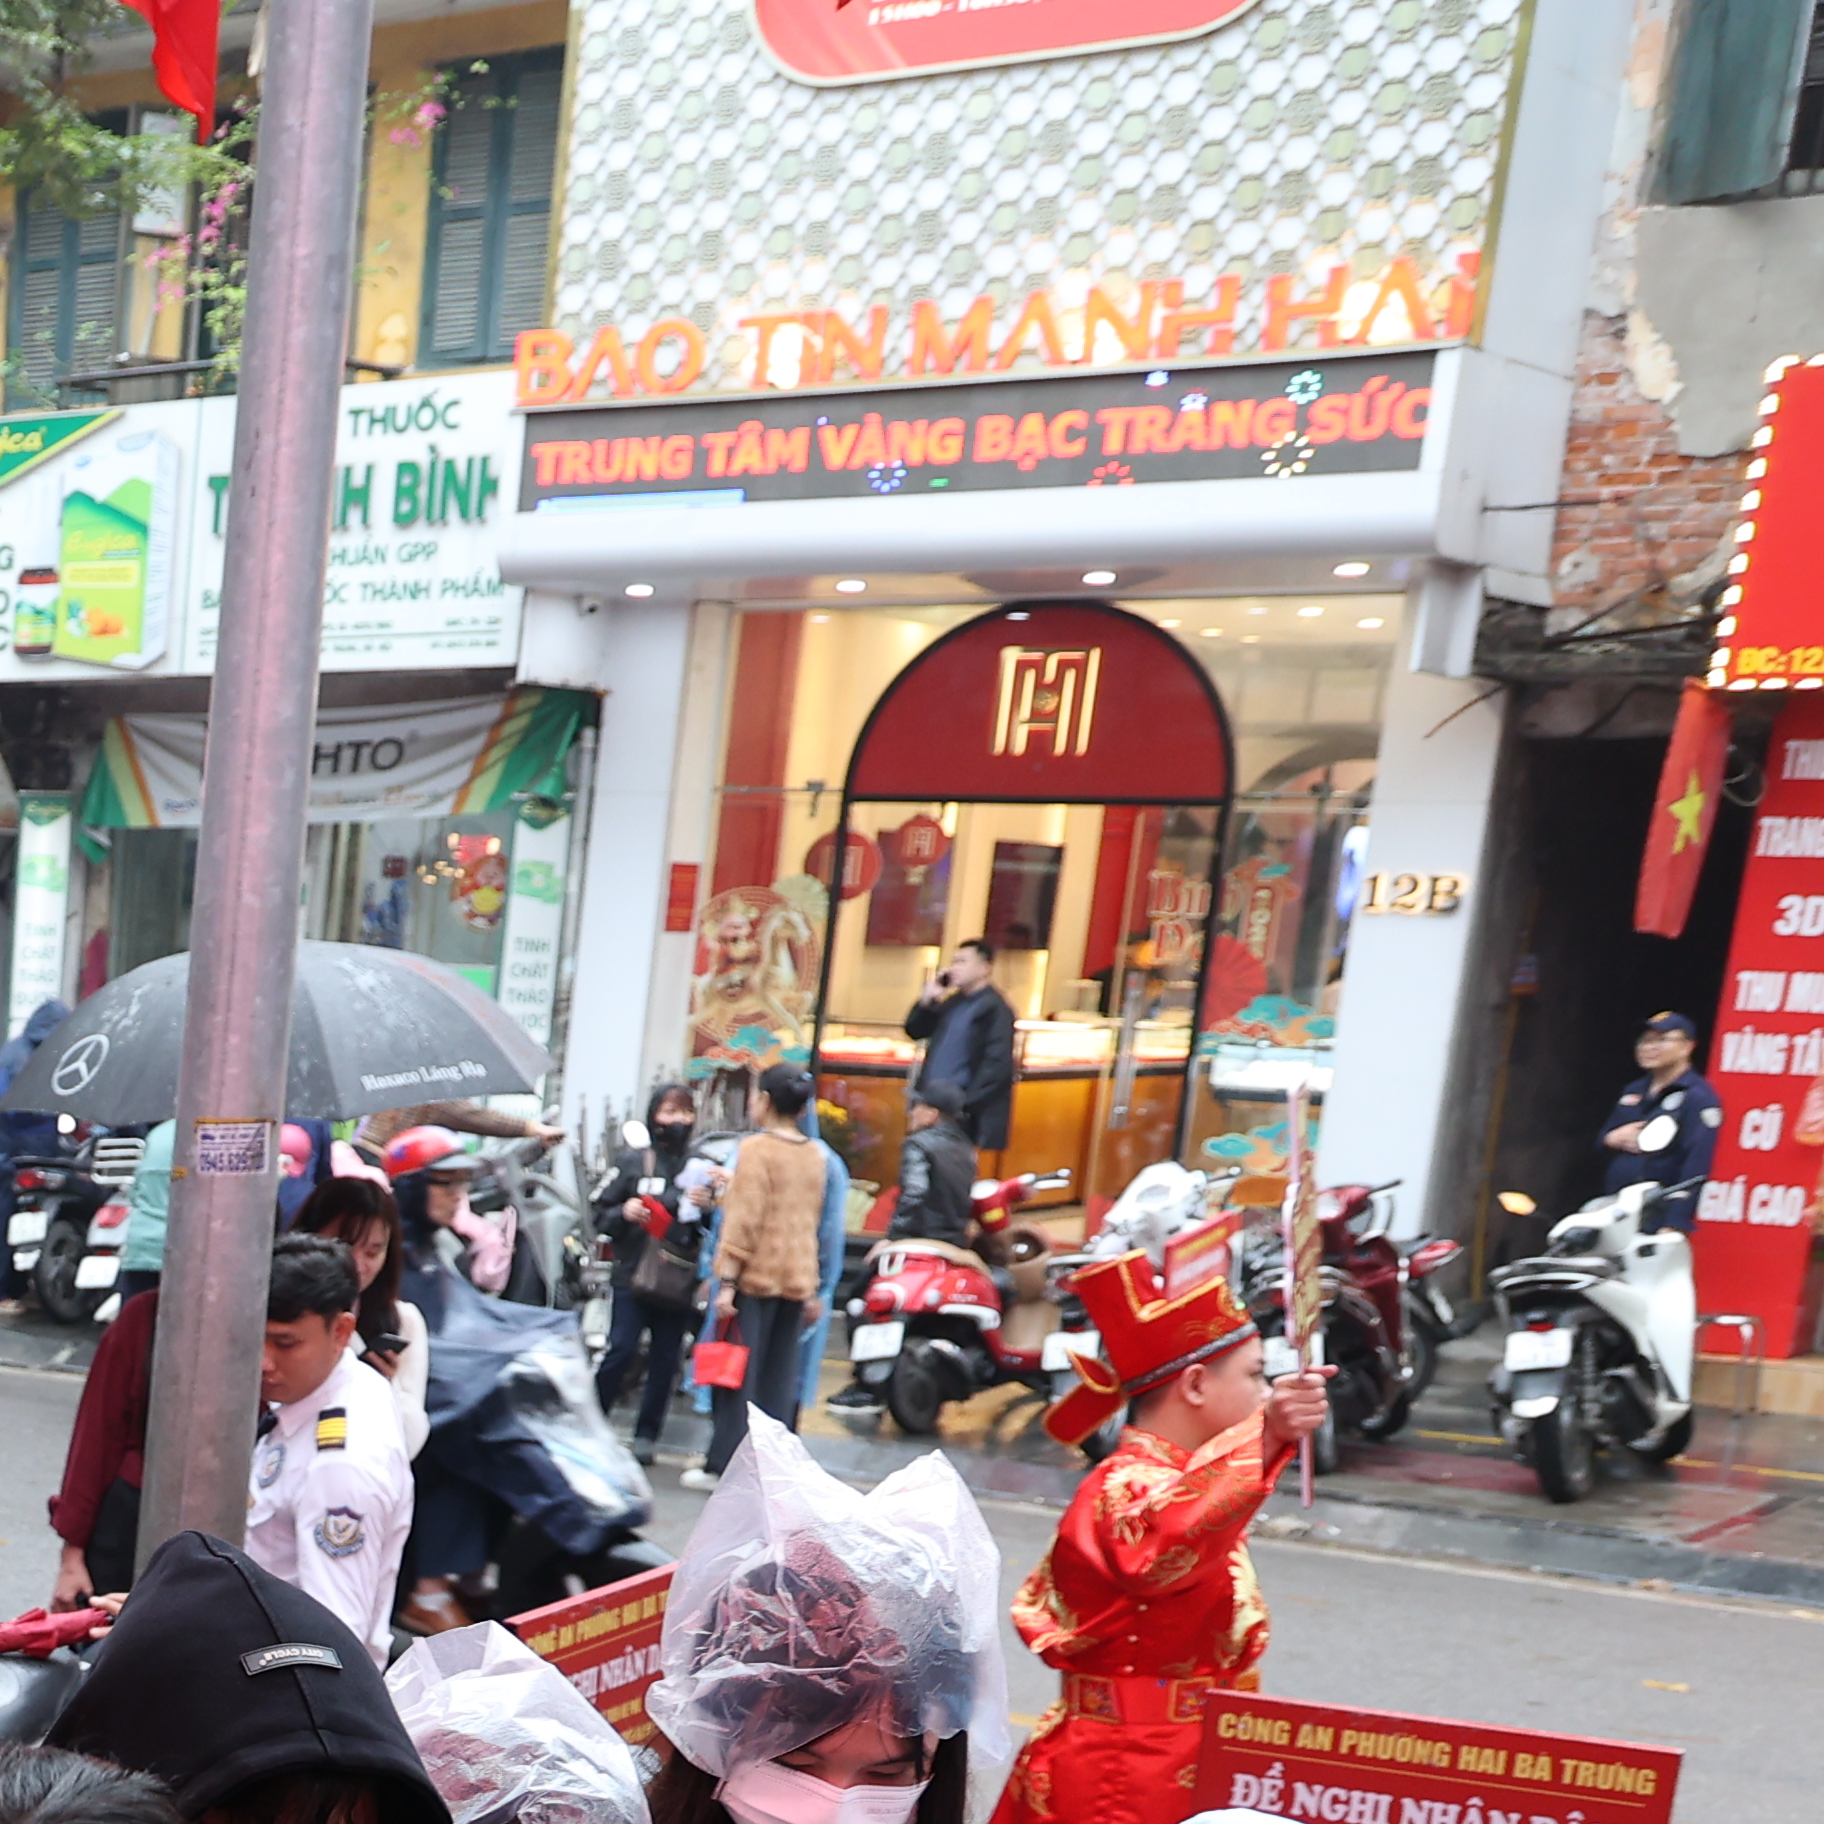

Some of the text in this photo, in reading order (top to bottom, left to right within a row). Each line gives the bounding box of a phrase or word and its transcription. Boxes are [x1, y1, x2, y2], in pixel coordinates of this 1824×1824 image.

[348, 387, 462, 437] THUỐC
[531, 433, 695, 488] TRUNG
[701, 420, 811, 479] TÂM
[815, 412, 968, 471] VÀNG
[972, 409, 1089, 473] BẠC
[1306, 374, 1435, 447] SỨC
[1363, 870, 1464, 919] 12B
[1734, 970, 1787, 1013] THU
[1719, 1025, 1789, 1076] VÀNG
[1738, 1103, 1785, 1152] CŨ
[1696, 1176, 1806, 1228] GIÁ CAO
[263, 1647, 324, 1662] CITY CYCLE
[1216, 1711, 1659, 1797] CÔNG AN PHƯỜNG HAI BÀ TRƯNG
